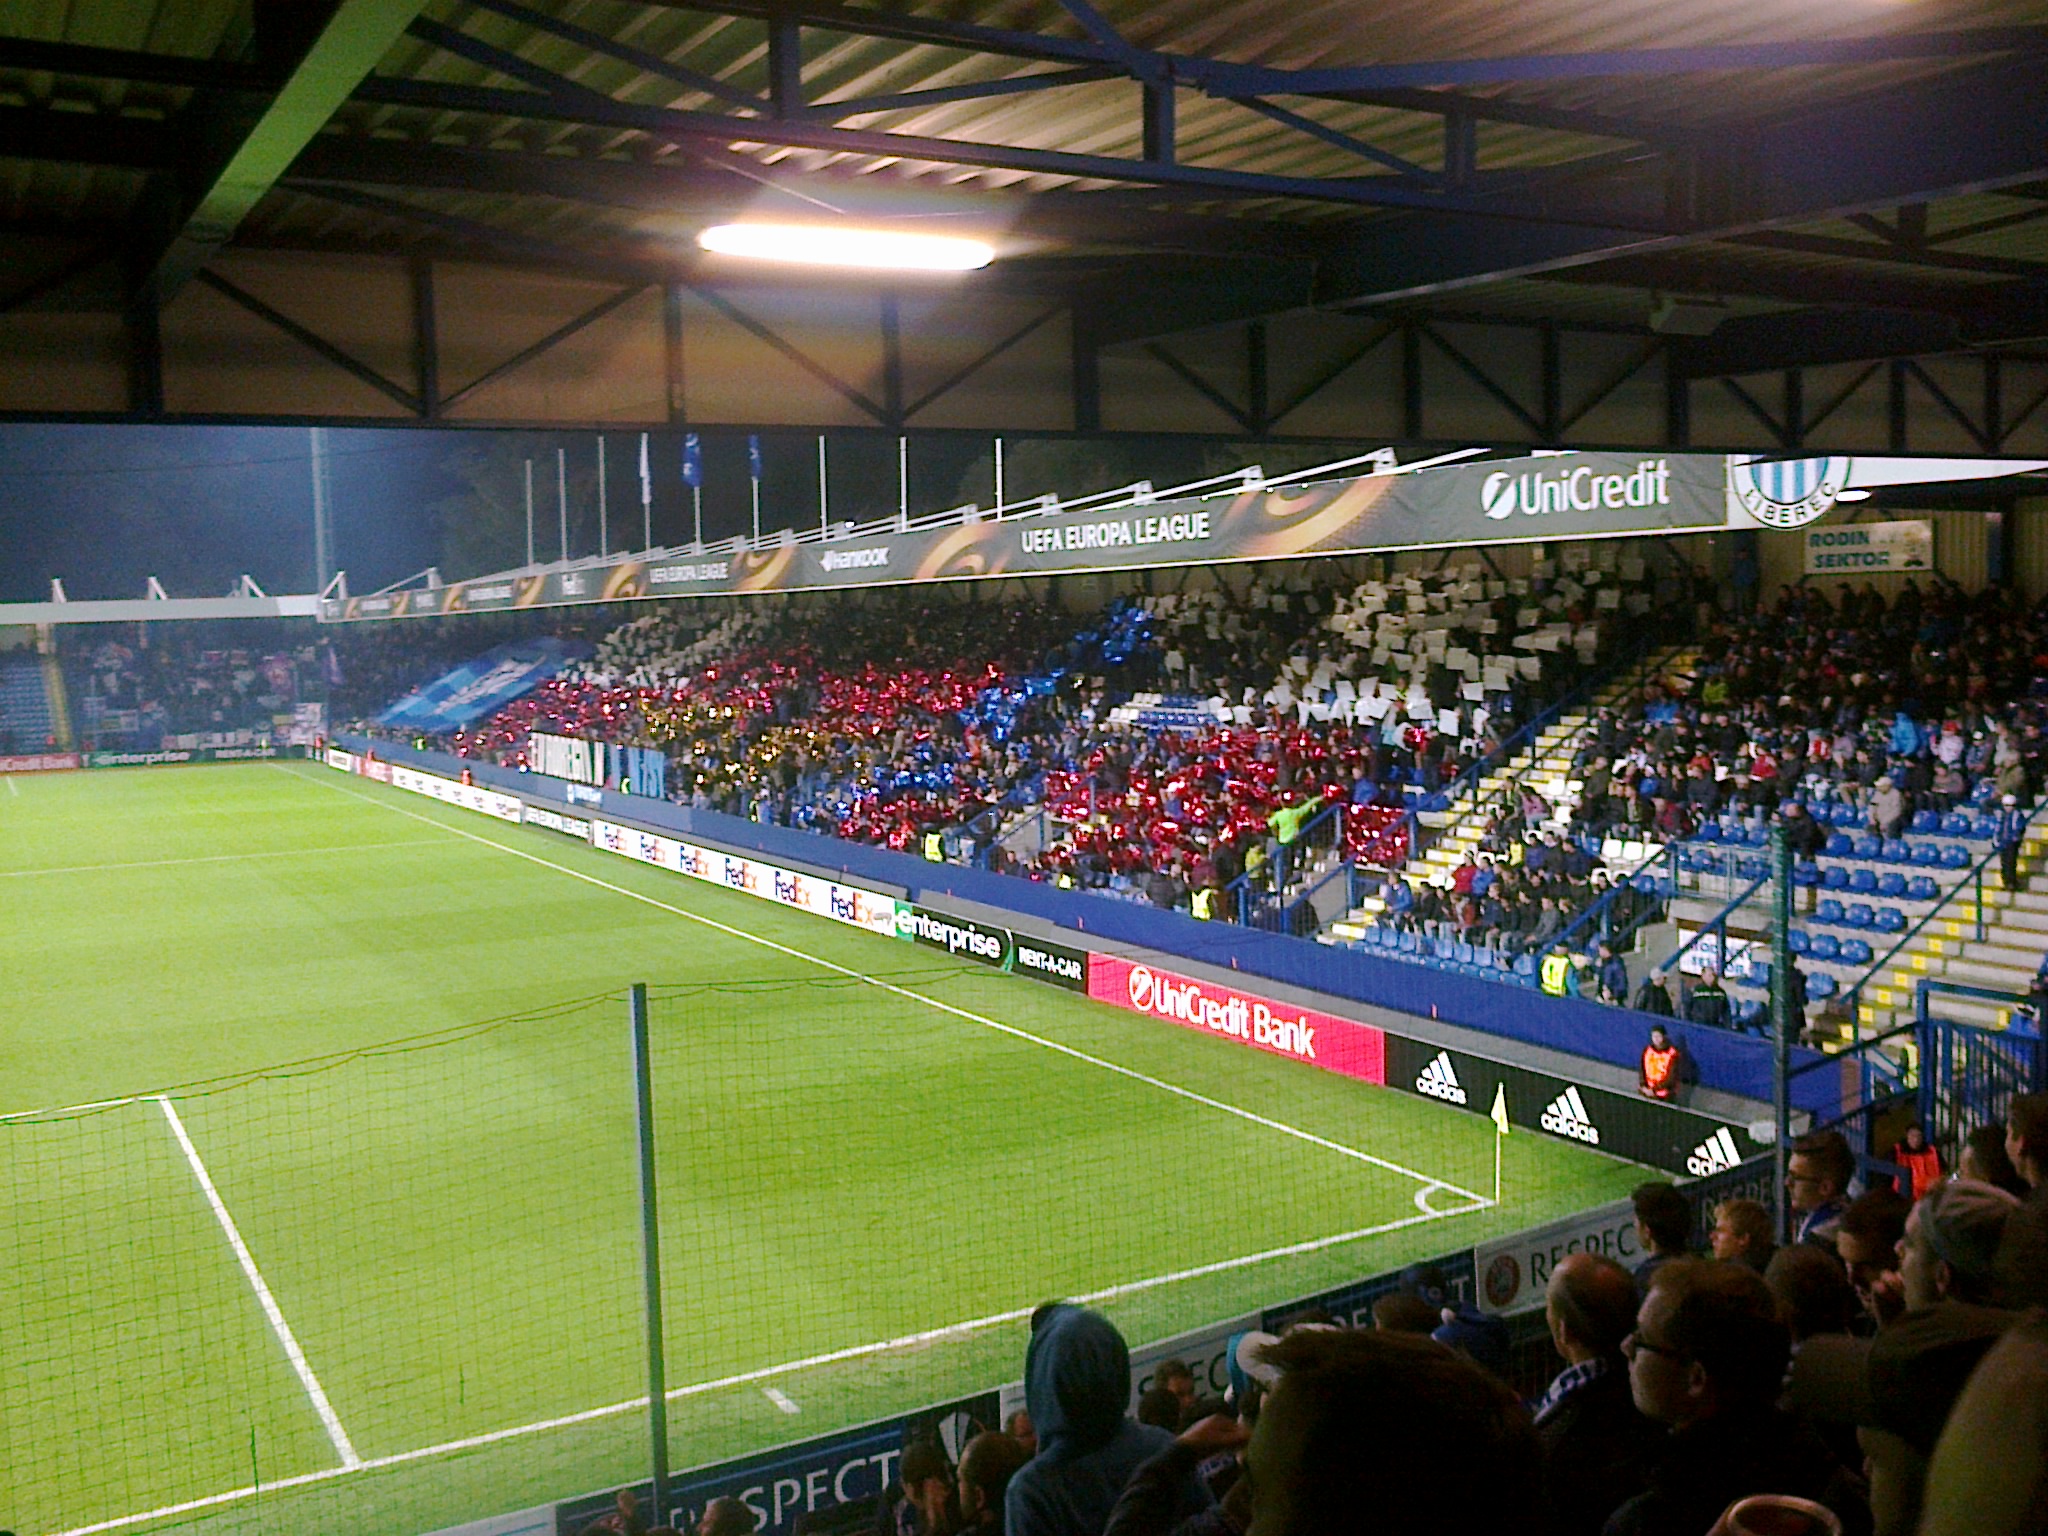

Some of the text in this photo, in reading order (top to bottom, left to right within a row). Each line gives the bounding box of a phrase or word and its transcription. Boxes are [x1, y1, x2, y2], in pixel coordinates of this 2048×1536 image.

[1520, 459, 1669, 515] UniCredit
[1745, 482, 1836, 523] LIBEREC
[1021, 512, 1210, 553] UEFA EUROPA LEAGUE
[1815, 552, 1889, 567] SEKTOR
[680, 845, 709, 876] FedEx
[725, 857, 757, 891] FedEx
[775, 871, 811, 907] FedEx
[831, 886, 873, 925] FedEx
[897, 908, 1082, 980] enterprise RENT-A-CAR
[1154, 977, 1316, 1059] UniCredit Bank
[1416, 1077, 1466, 1104] adidas
[1541, 1113, 1599, 1144] adidas
[670, 1449, 899, 1536] SPECT
